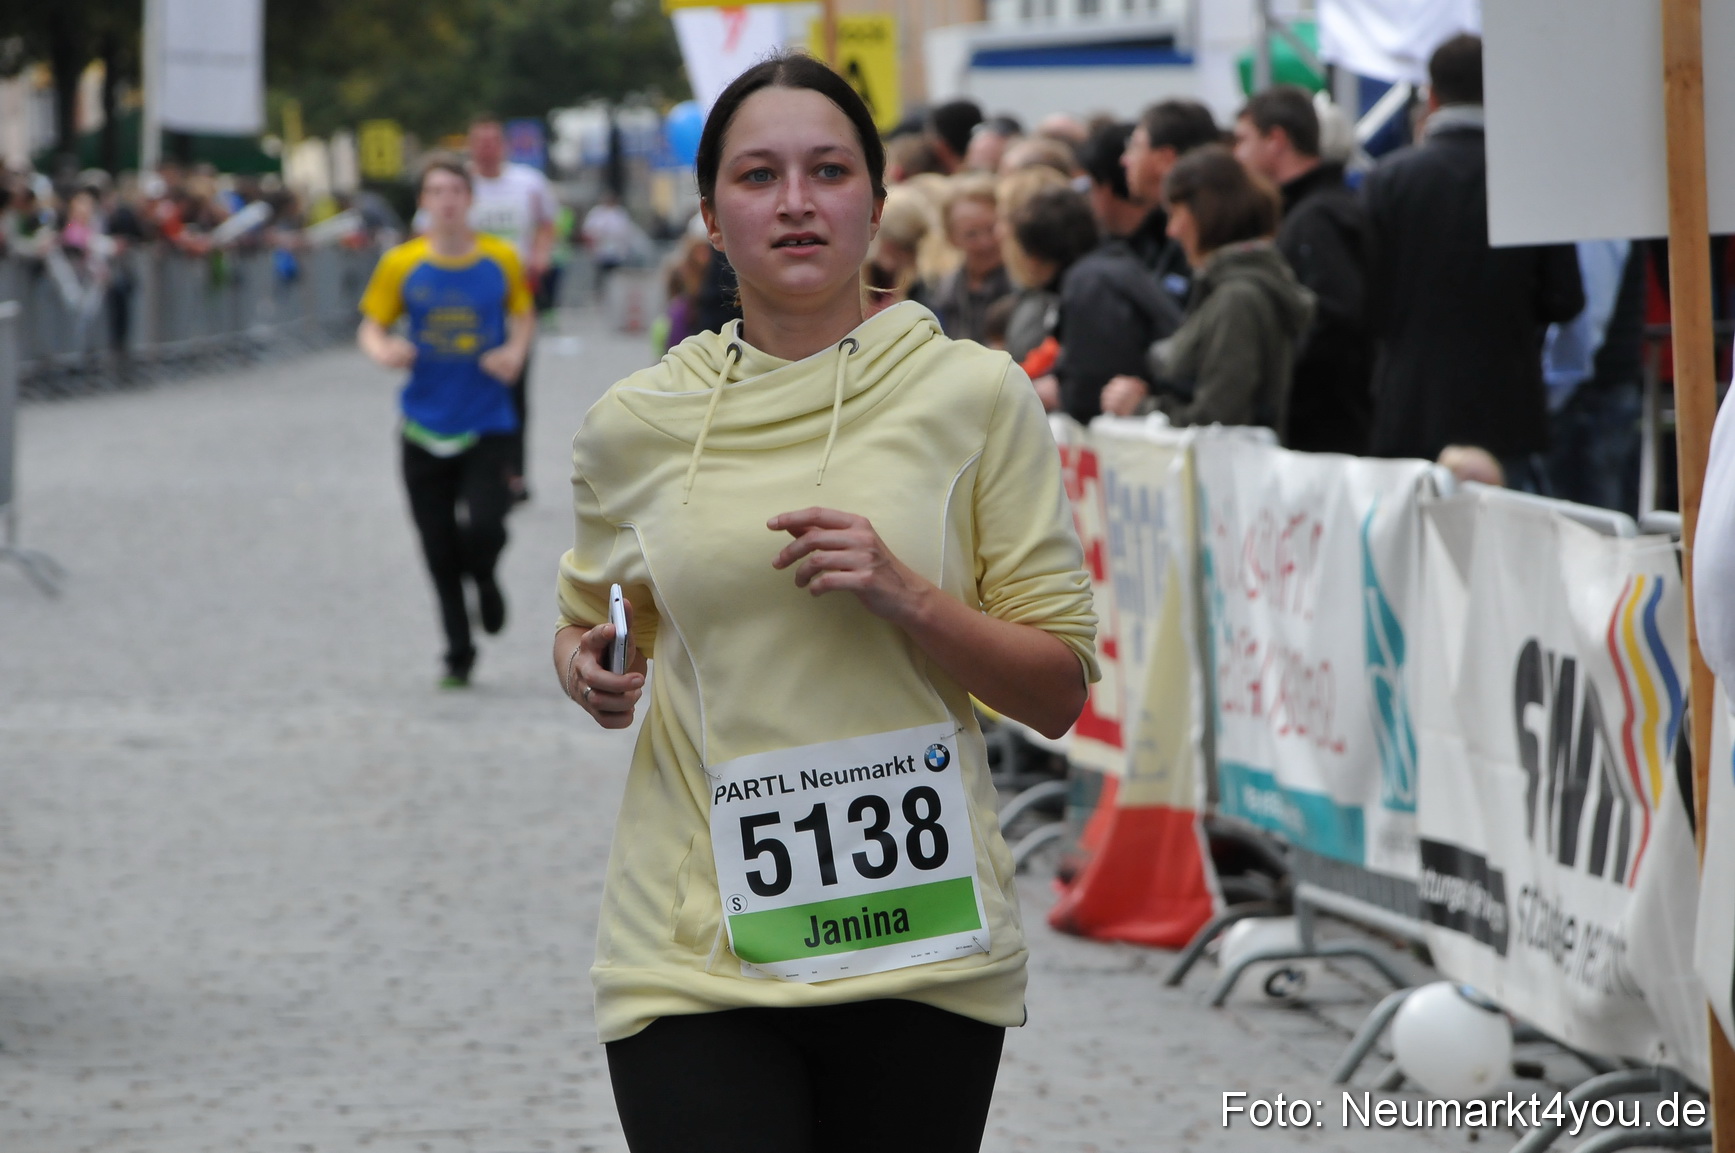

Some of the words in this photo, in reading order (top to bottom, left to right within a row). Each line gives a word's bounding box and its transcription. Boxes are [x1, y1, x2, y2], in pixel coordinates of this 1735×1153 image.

[714, 774, 795, 805] PARTL
[800, 754, 916, 790] Neumarkt
[739, 785, 949, 897] 5138
[731, 897, 742, 912] S
[803, 906, 910, 948] Janina
